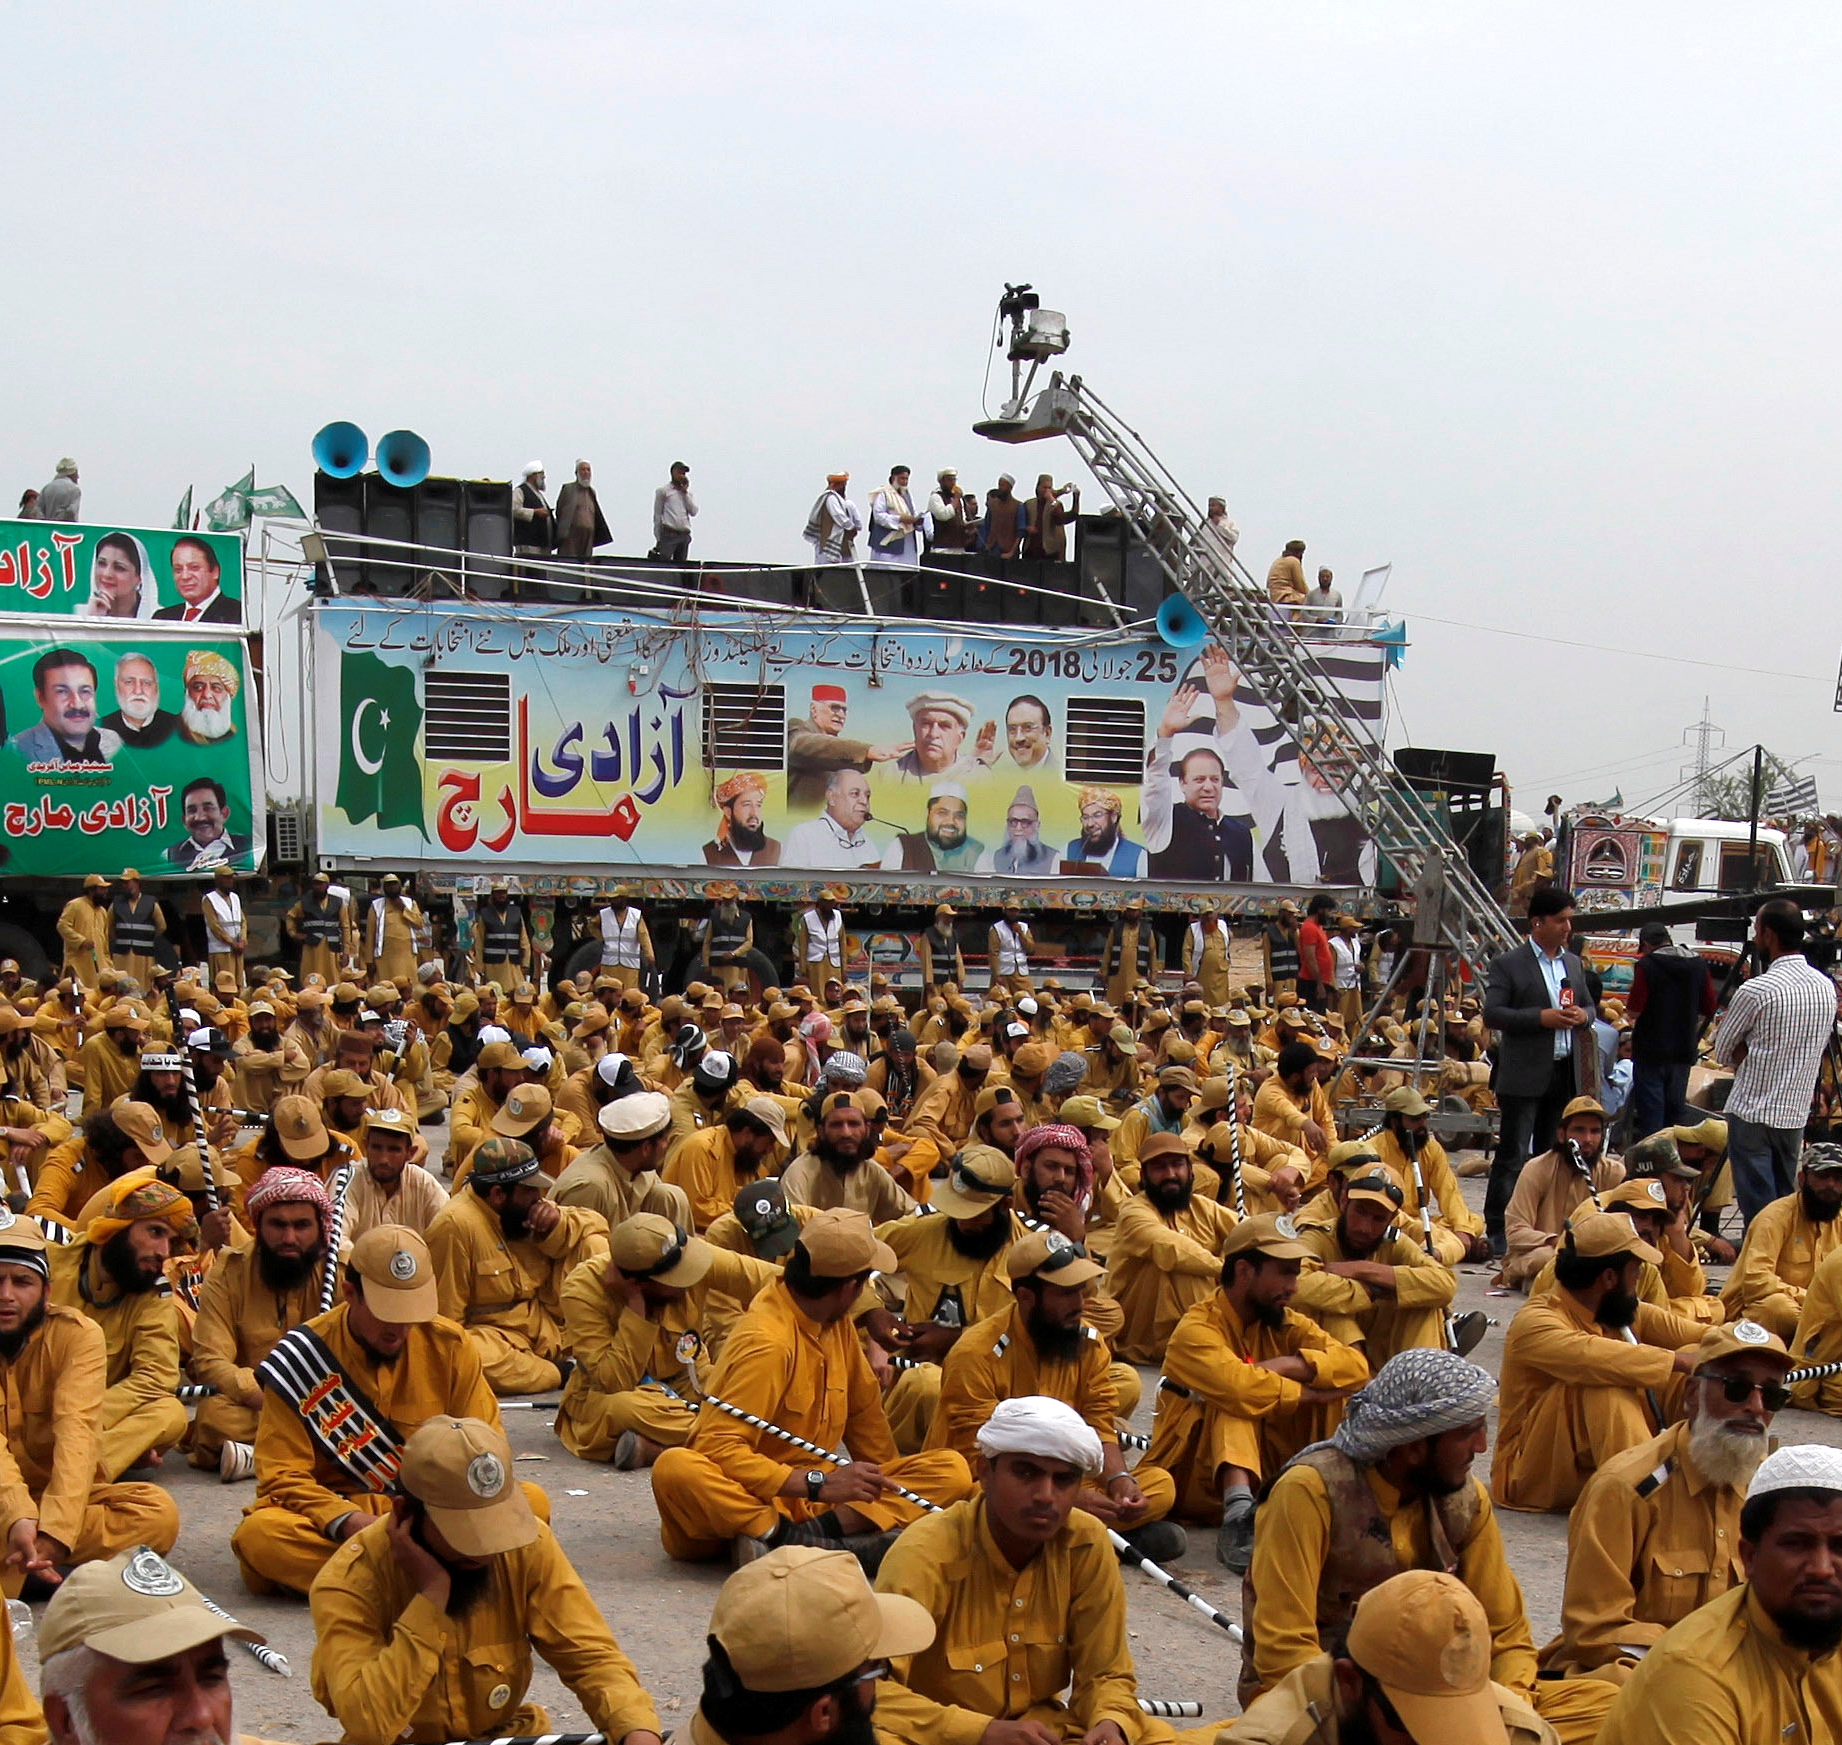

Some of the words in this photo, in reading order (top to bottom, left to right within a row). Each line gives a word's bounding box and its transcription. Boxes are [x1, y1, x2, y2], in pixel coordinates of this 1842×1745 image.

[1008, 647, 1081, 678] 2018
[1081, 650, 1133, 683] جولائی
[1135, 651, 1178, 684] 25
[532, 682, 698, 805] آزادی
[437, 693, 642, 853] مارچ
[4, 793, 76, 837] مارچ
[78, 785, 173, 835] آزادی
[1635, 1161, 1654, 1173] JUI
